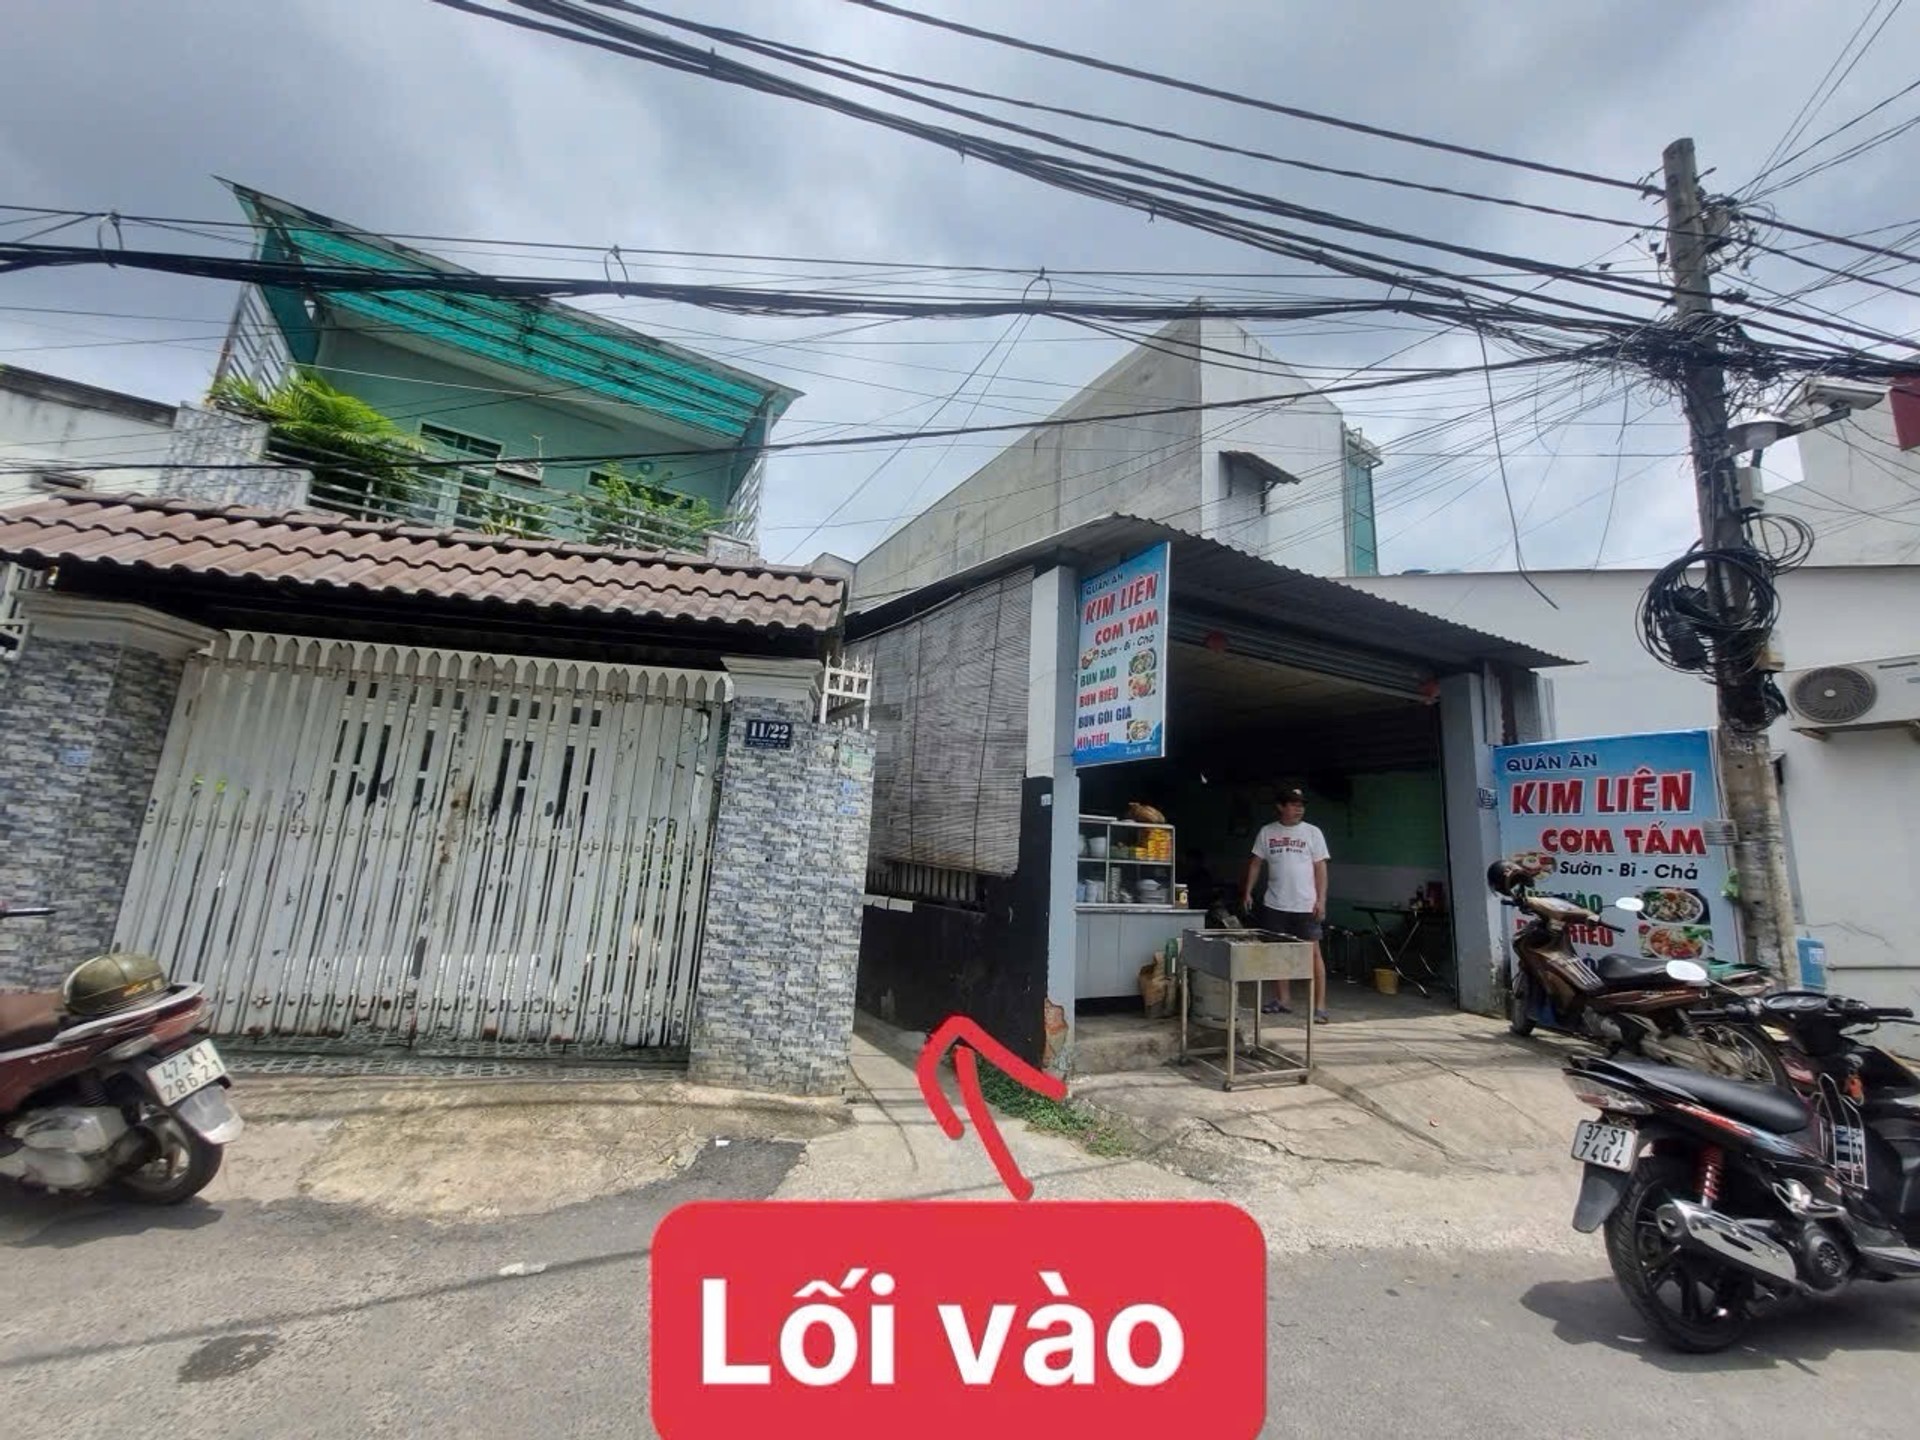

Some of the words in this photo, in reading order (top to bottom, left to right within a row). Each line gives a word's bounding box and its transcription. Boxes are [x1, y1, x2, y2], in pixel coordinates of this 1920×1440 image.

[1085, 592, 1116, 625] KIM
[751, 722, 789, 739] 11/22
[1506, 753, 1562, 772] QUÁN
[1512, 780, 1584, 815] KIM
[1597, 768, 1693, 814] LIÊN
[1541, 828, 1615, 854] CƠM
[1624, 821, 1707, 855] TẤM
[1560, 861, 1603, 876] Sườn
[1619, 861, 1636, 877] Bì
[1654, 862, 1698, 880] Chả
[1579, 1141, 1623, 1166] 7404
